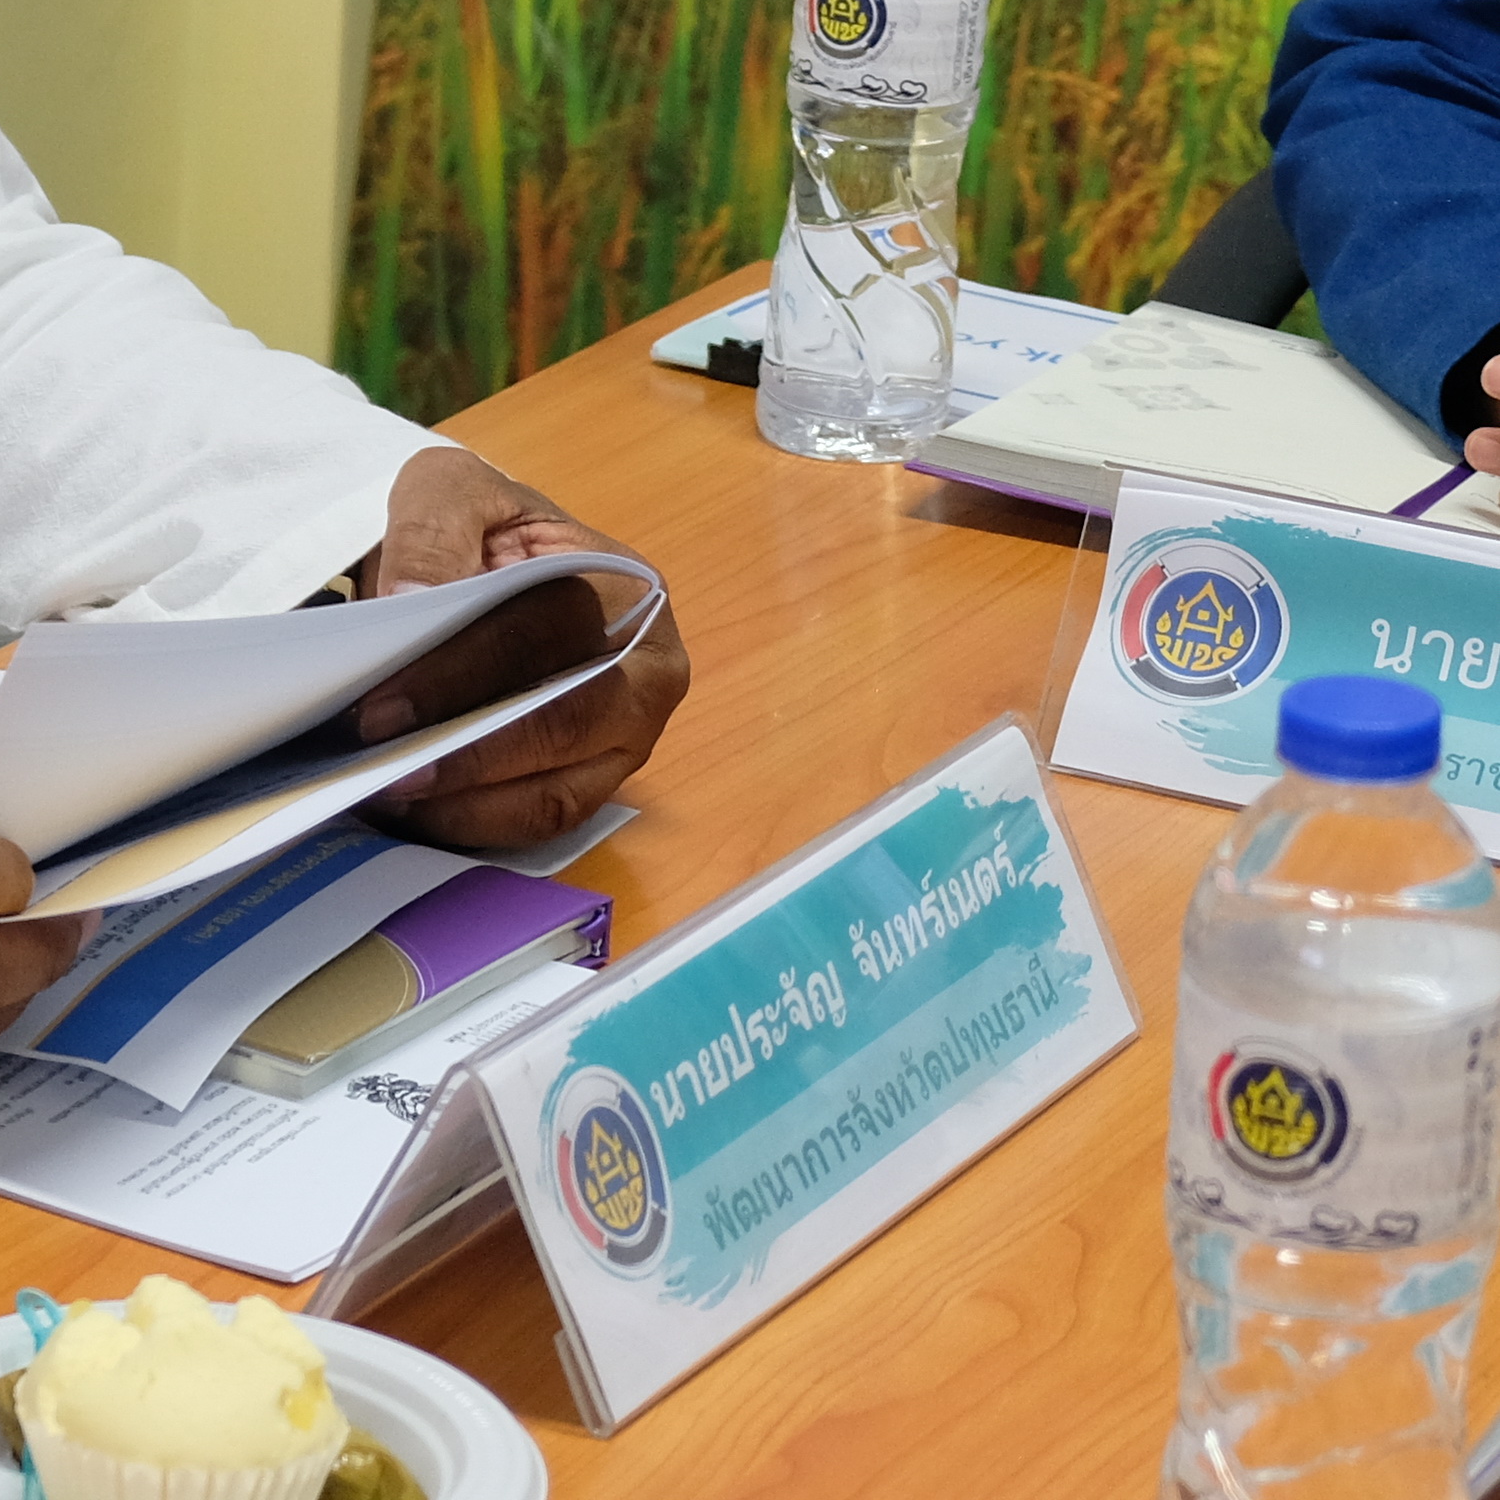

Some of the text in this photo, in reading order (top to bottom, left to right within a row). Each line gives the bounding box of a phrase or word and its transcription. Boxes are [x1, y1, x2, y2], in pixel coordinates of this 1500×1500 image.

[1371, 618, 1500, 690] นาย
[702, 952, 1060, 1251] พัฒนาการจังหวัดปทุมธานี
